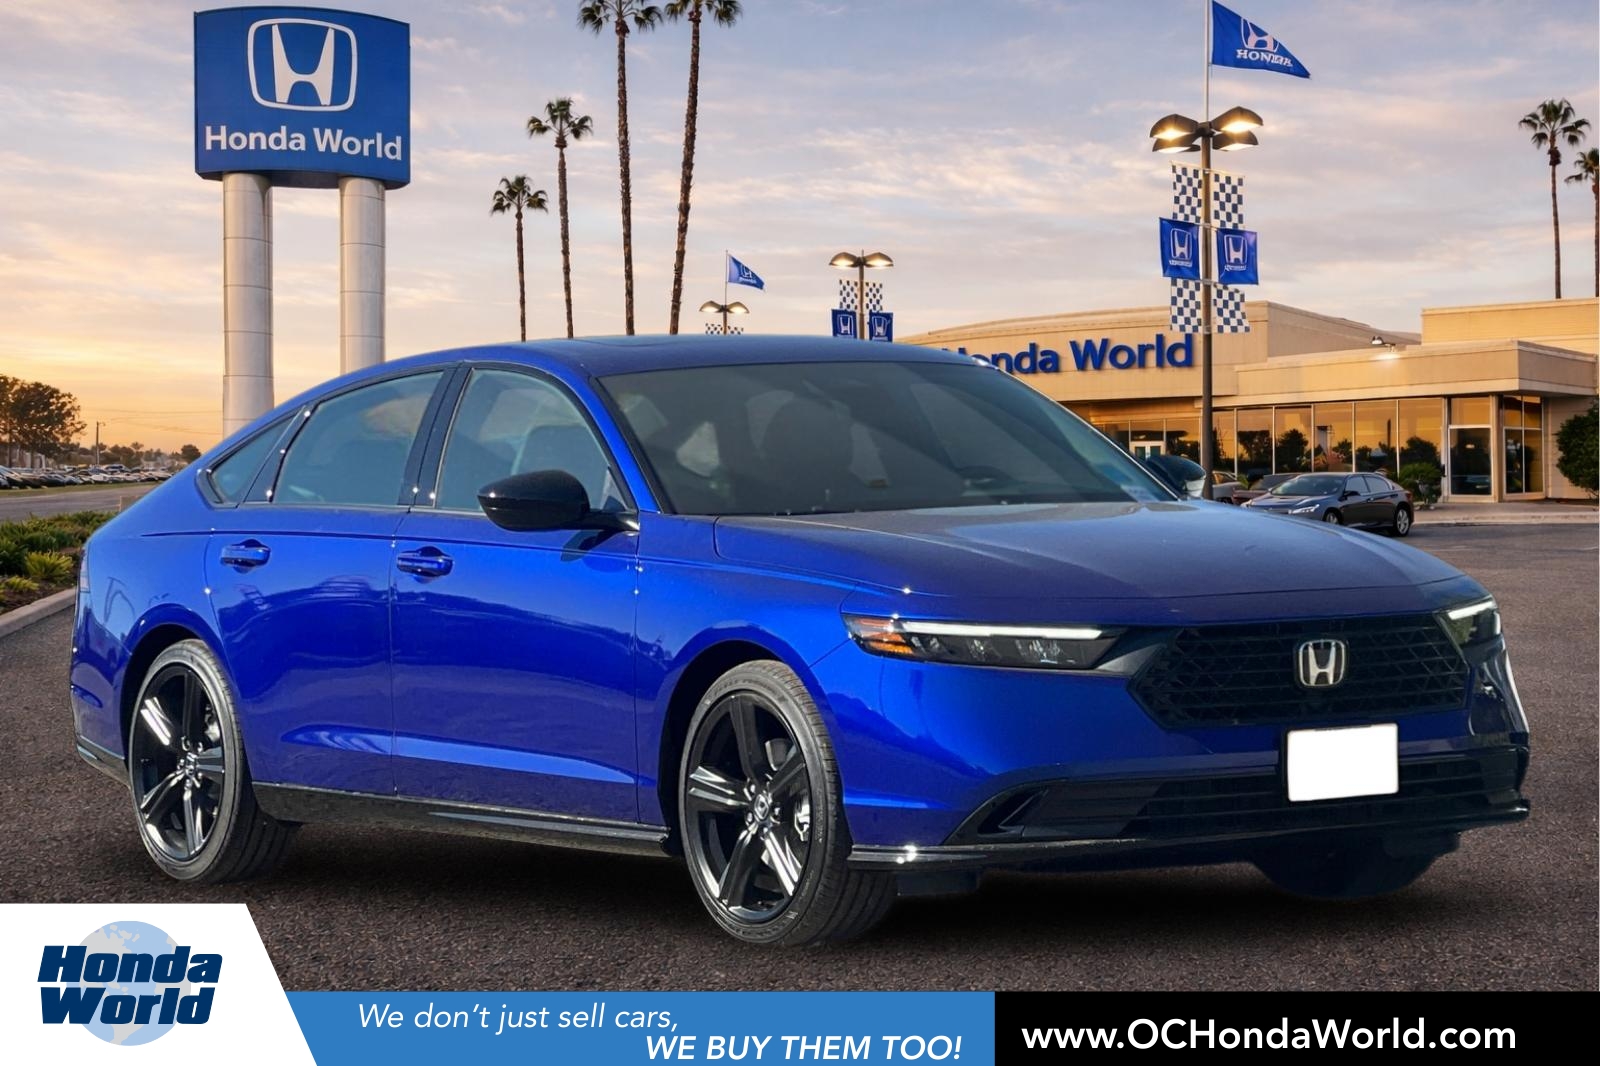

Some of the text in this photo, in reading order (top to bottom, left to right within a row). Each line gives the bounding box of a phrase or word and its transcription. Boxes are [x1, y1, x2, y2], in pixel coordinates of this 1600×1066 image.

[205, 125, 402, 161] Honda World
[941, 333, 1193, 374] nda World
